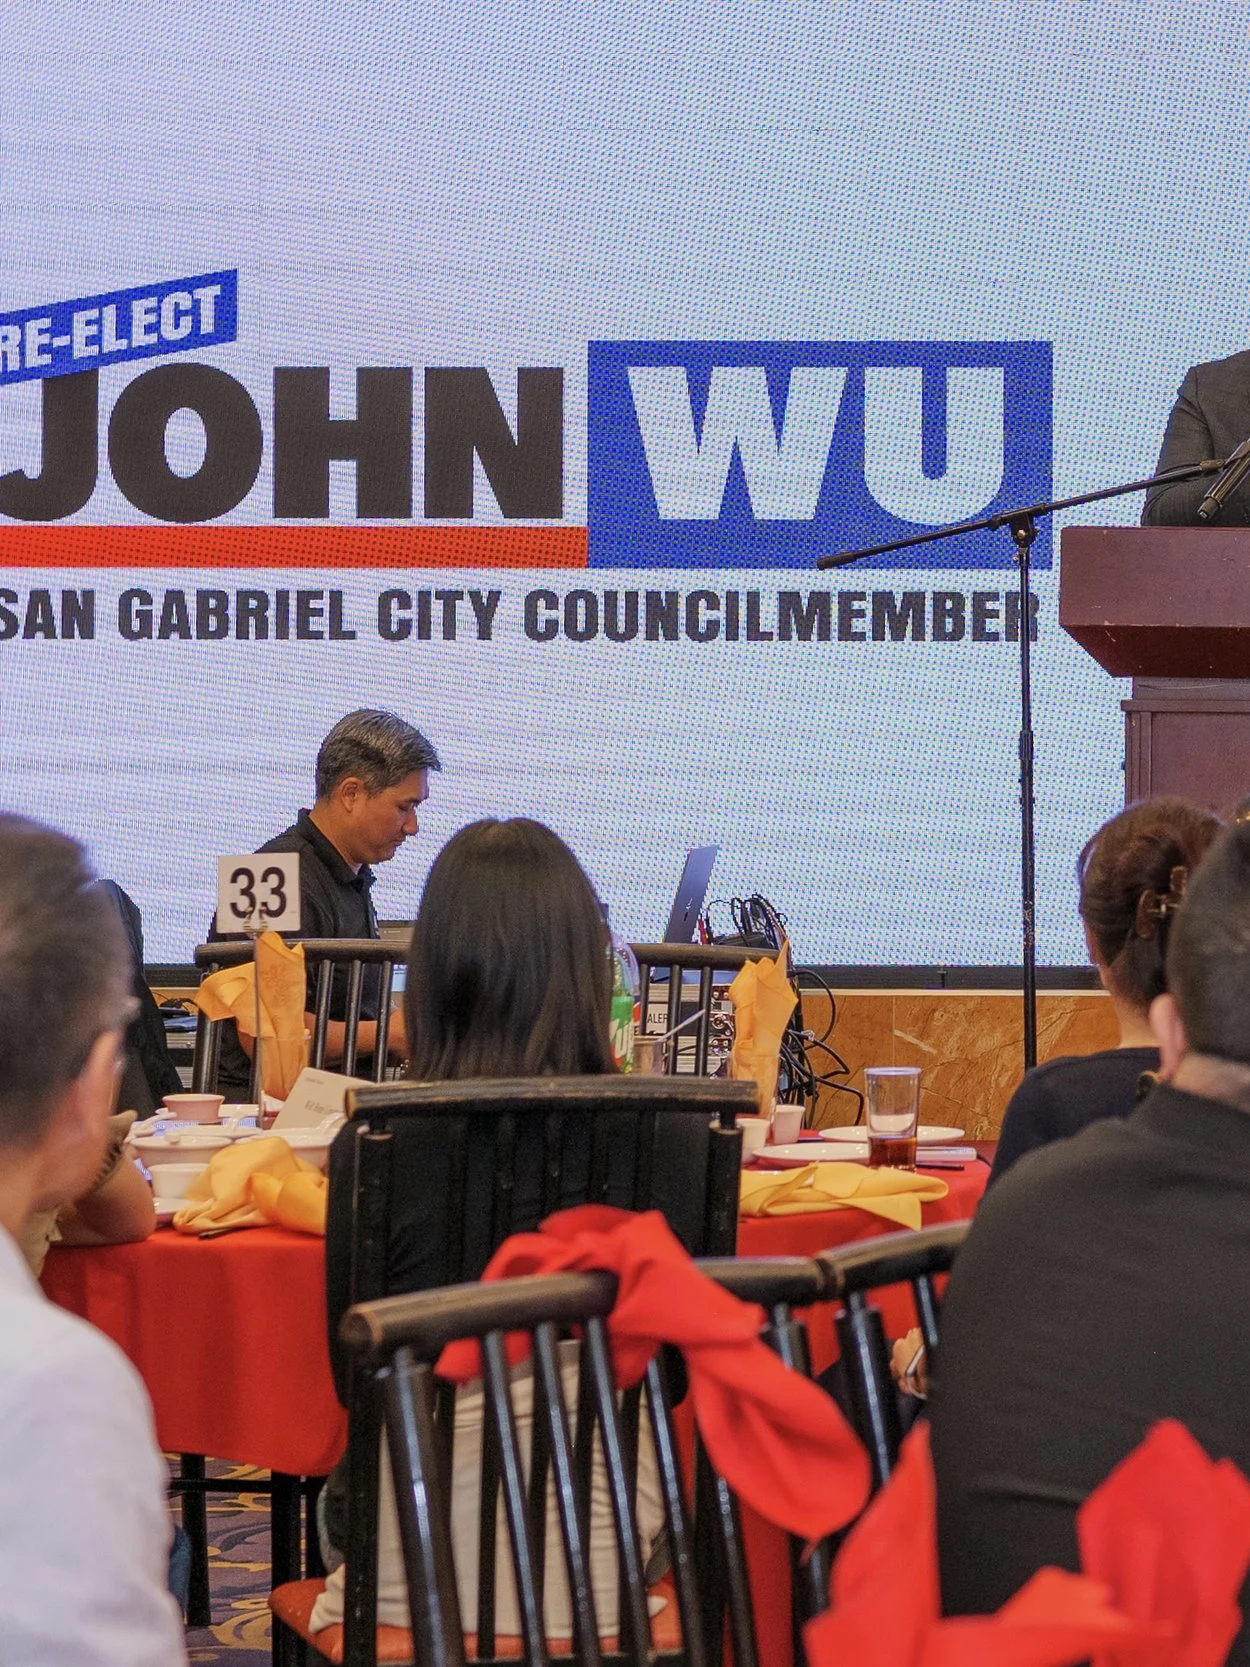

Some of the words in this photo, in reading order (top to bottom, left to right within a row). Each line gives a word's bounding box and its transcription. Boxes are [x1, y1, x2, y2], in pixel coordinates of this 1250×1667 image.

[0, 285, 221, 372] RE-ELECT
[0, 361, 564, 523] JOHN
[627, 366, 1004, 524] WU
[0, 588, 95, 641] SAN
[118, 588, 357, 641] GABRIEL
[377, 588, 502, 641] CITY
[524, 589, 1040, 642] COUNCILMEMBER
[230, 867, 287, 918] 33
